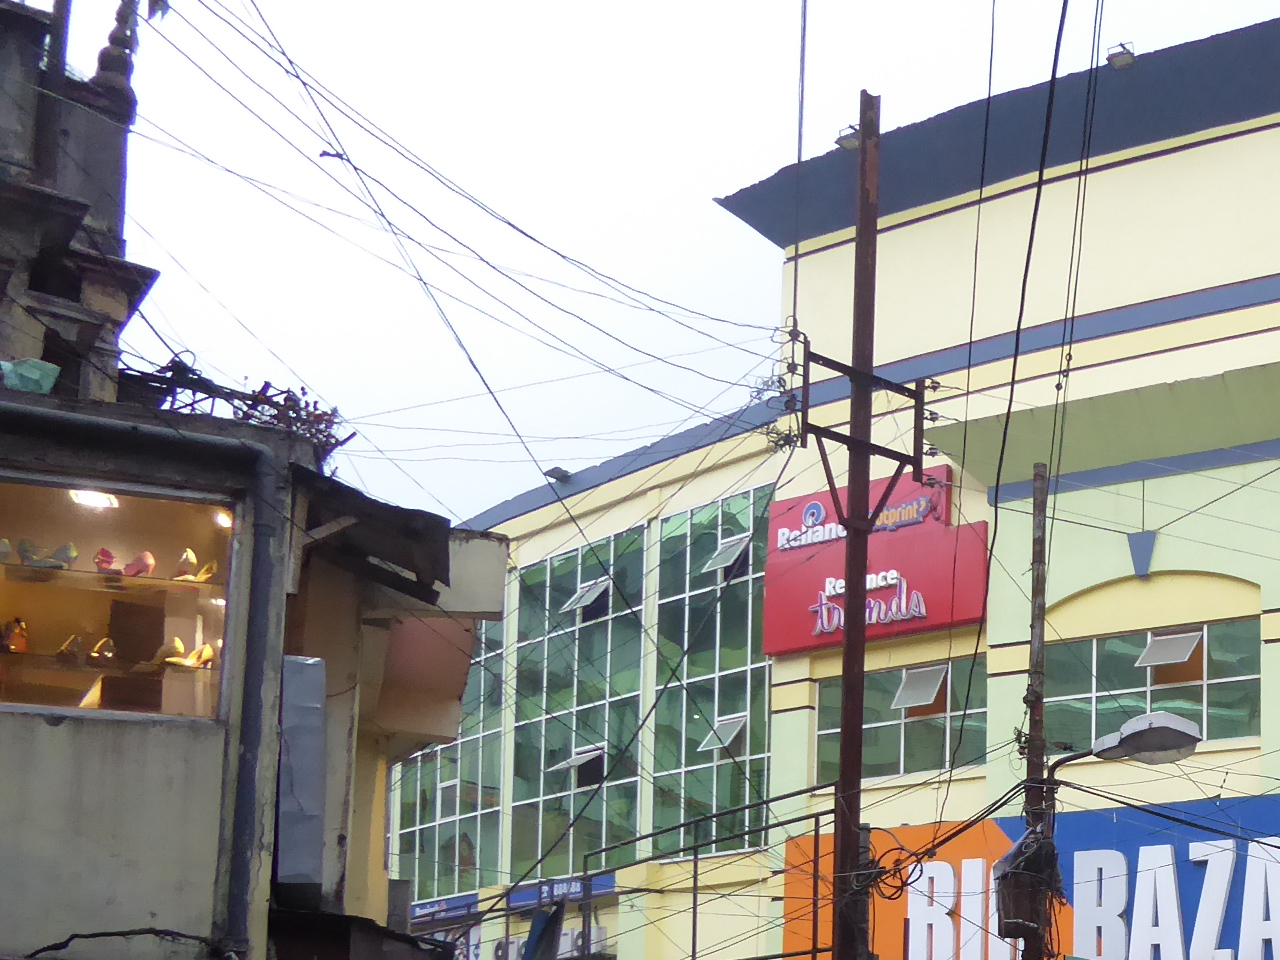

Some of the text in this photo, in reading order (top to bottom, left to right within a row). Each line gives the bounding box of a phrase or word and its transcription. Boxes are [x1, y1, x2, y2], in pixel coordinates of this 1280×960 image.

[777, 522, 847, 550] Relianc
[825, 569, 898, 596] Rence
[809, 576, 927, 636] trnds
